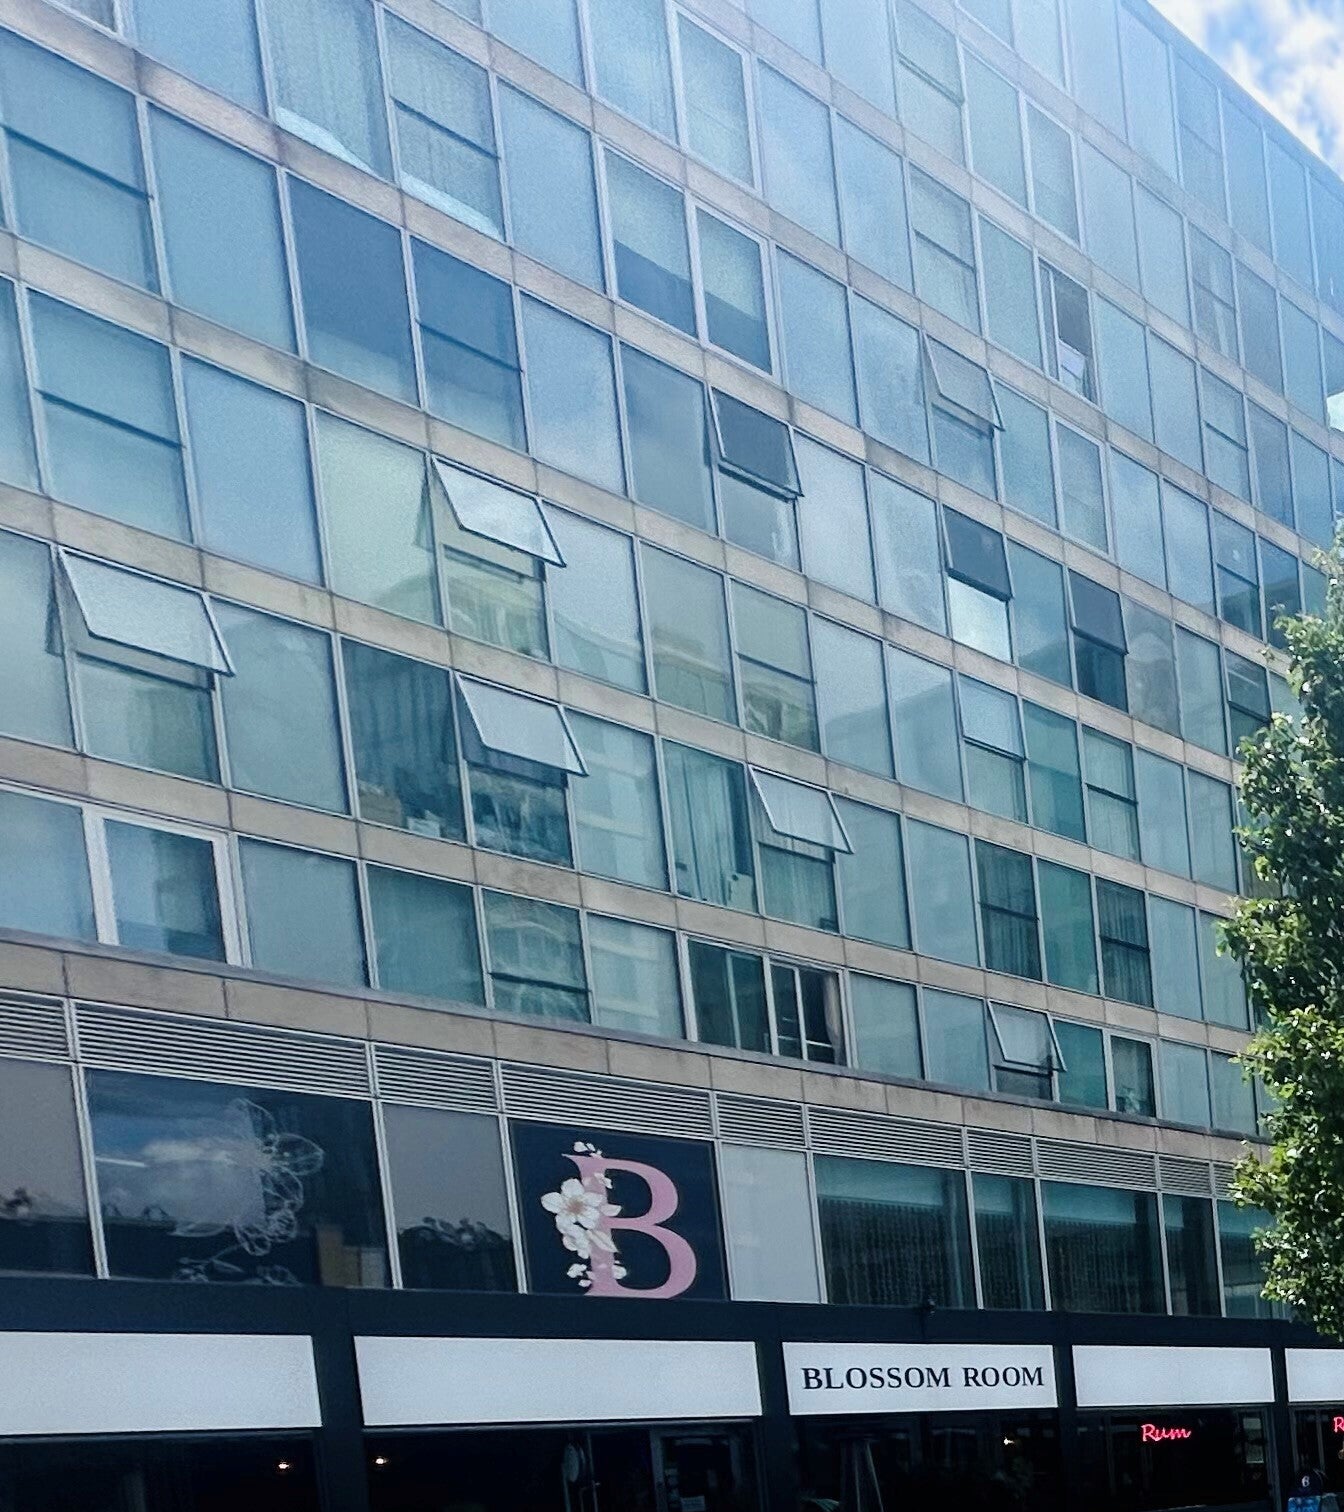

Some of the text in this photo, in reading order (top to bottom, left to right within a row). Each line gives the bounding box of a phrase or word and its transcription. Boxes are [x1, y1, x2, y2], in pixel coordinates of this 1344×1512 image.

[562, 1153, 697, 1299] B
[802, 1365, 1045, 1390] BLOSSOM ROOM
[1141, 1423, 1192, 1442] Rum
